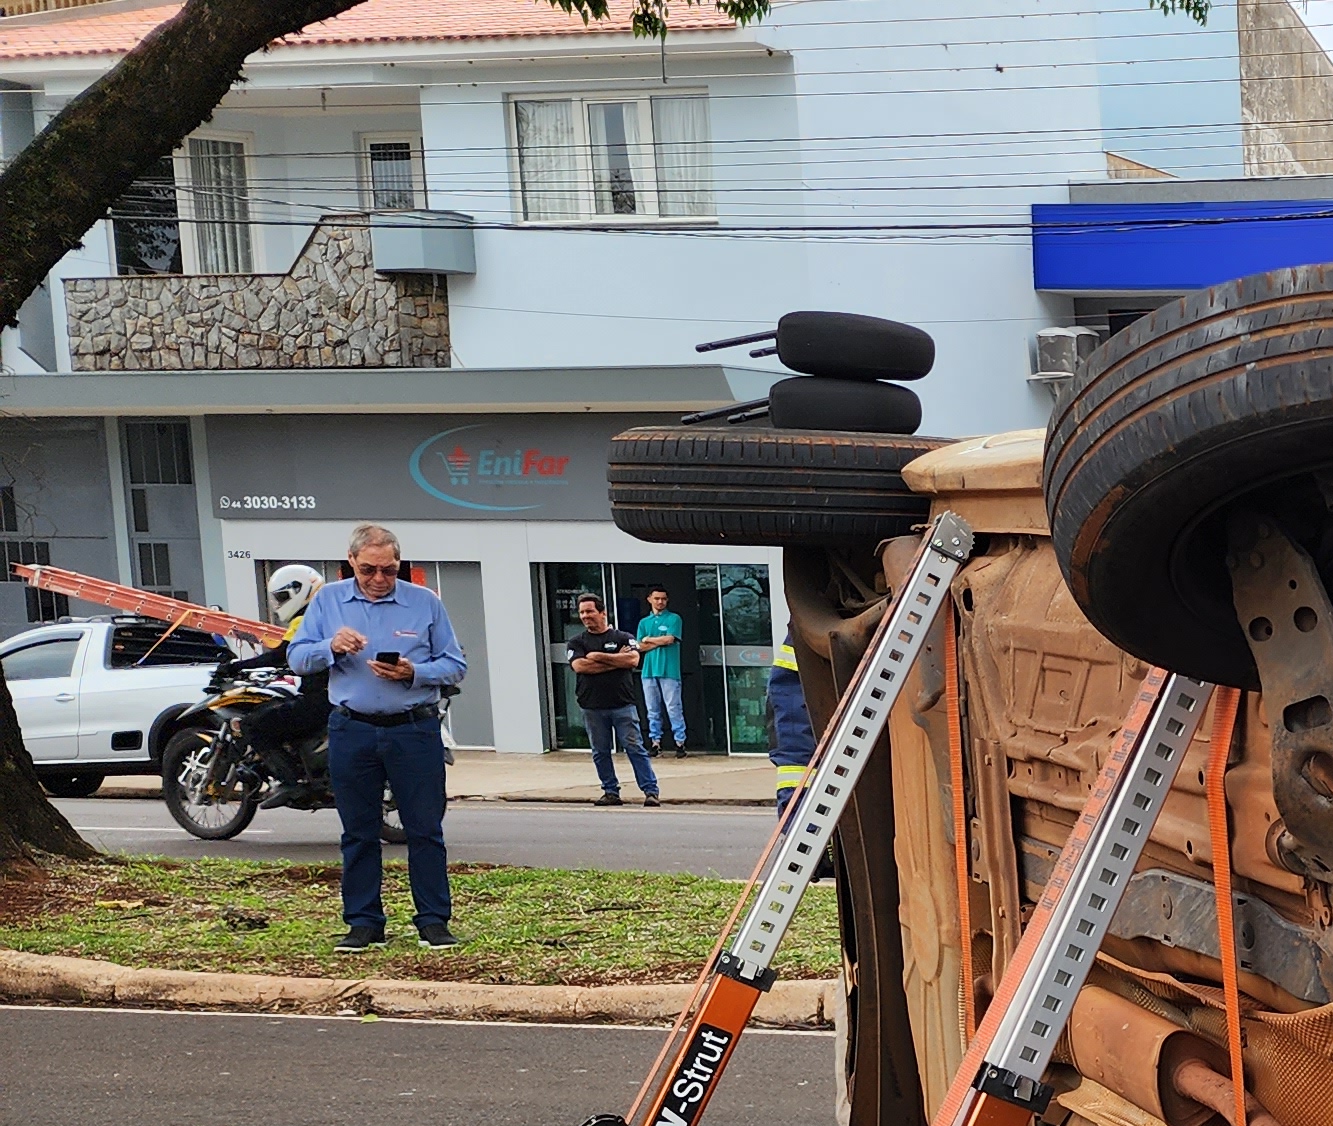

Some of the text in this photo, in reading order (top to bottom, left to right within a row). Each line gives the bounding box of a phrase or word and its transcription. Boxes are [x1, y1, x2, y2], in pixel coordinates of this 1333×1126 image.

[477, 448, 571, 477] EniFar
[243, 496, 316, 509] 3030-3133
[227, 550, 251, 559] 3426
